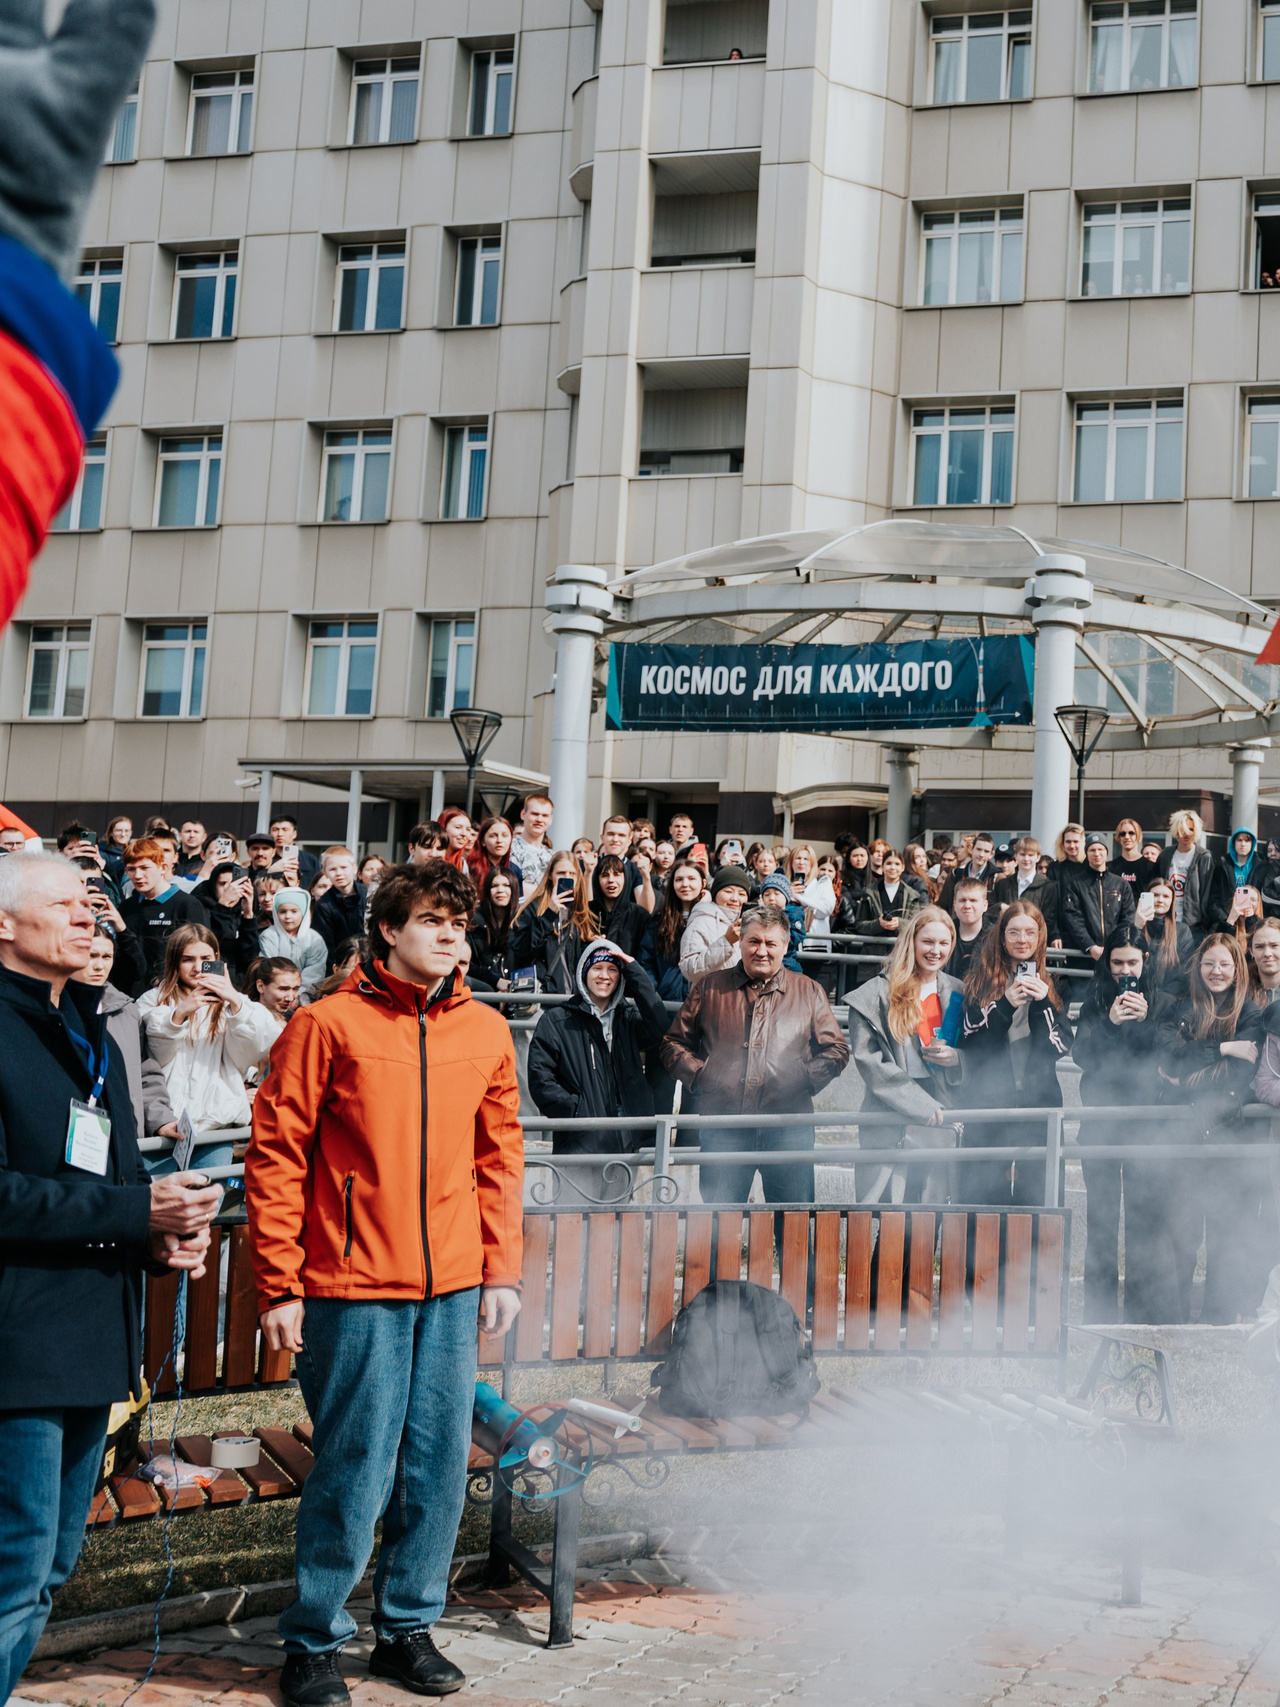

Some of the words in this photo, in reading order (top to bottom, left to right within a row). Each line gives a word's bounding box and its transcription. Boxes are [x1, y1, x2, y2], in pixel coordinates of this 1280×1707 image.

[640, 665, 747, 696] КОСМОС
[752, 665, 813, 701] ДЛЯ
[819, 660, 953, 698] КАЖДОГО
